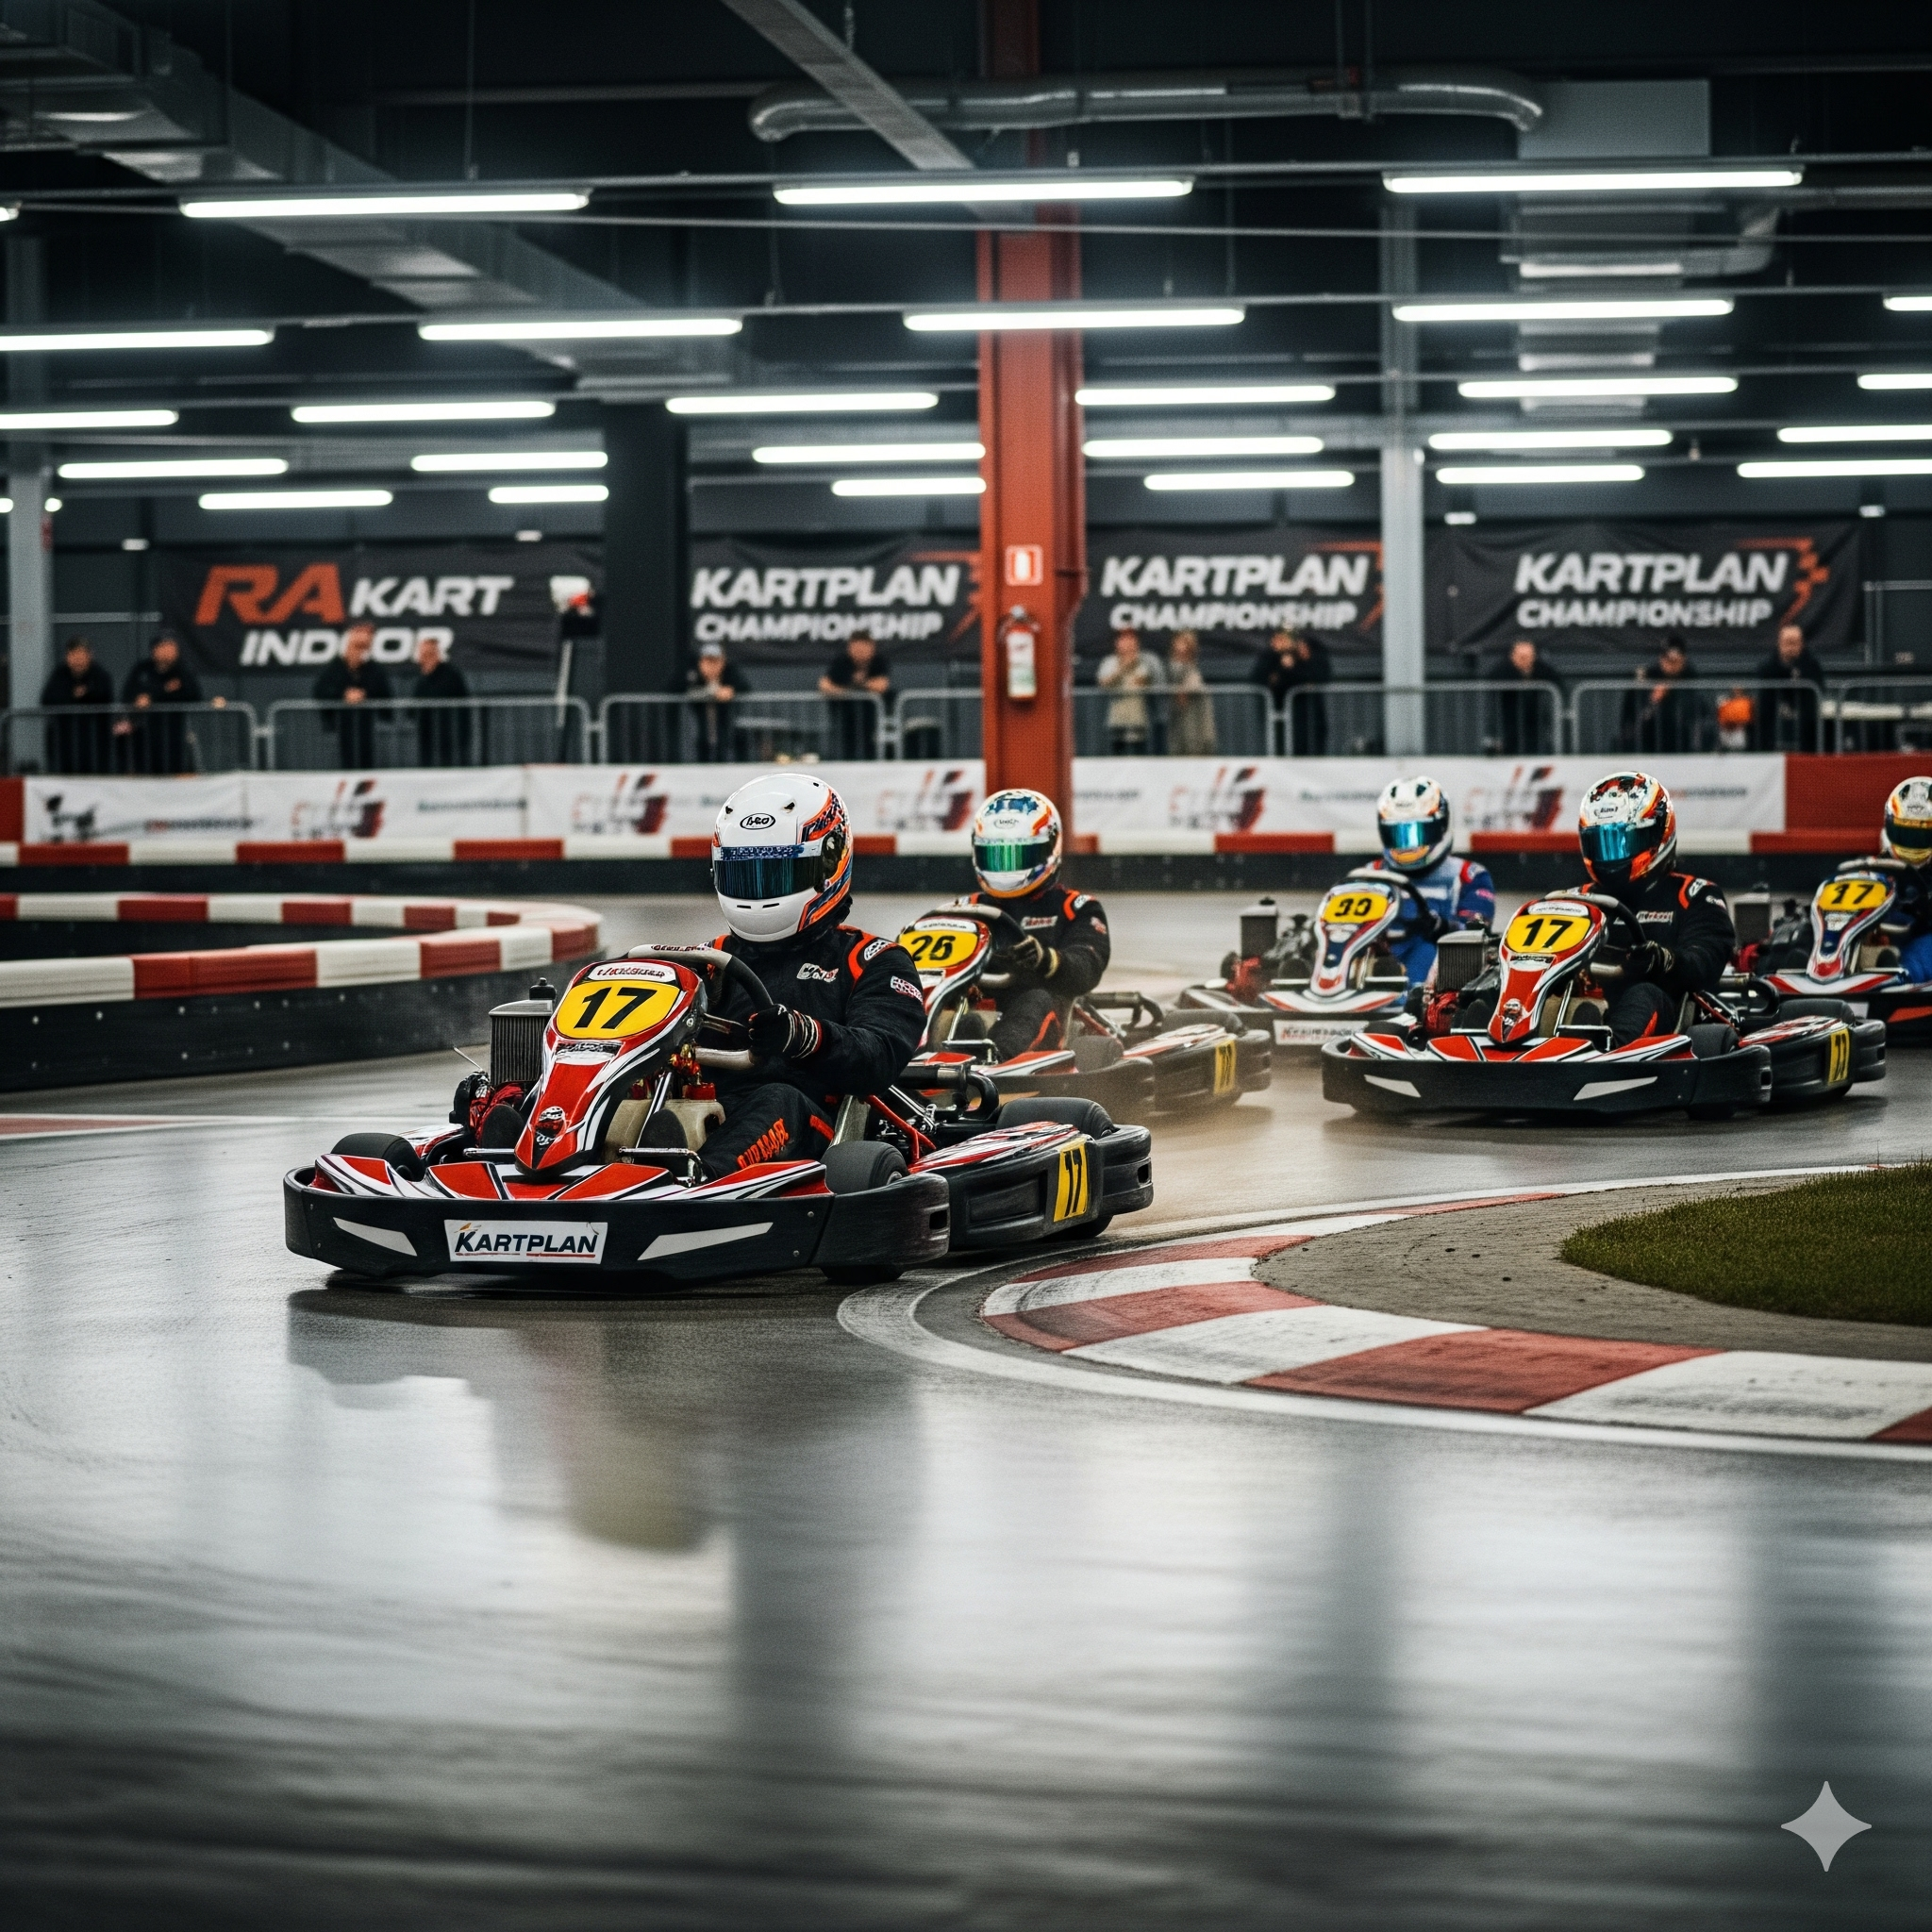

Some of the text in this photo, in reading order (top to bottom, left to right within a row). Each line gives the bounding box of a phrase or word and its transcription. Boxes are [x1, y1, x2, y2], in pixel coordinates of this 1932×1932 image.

[691, 566, 960, 608] KARTPLAN
[1101, 555, 1368, 596] KARTPLAN
[1515, 552, 1789, 593] KARTPLAN
[194, 563, 514, 625] RA KART
[1516, 599, 1773, 627] CHAMPIONSHIP
[1831, 884, 1874, 904] 17
[910, 935, 956, 961] 26
[1522, 918, 1574, 948] 17
[573, 987, 658, 1030] 17
[455, 1231, 598, 1253] KARTPLAN
